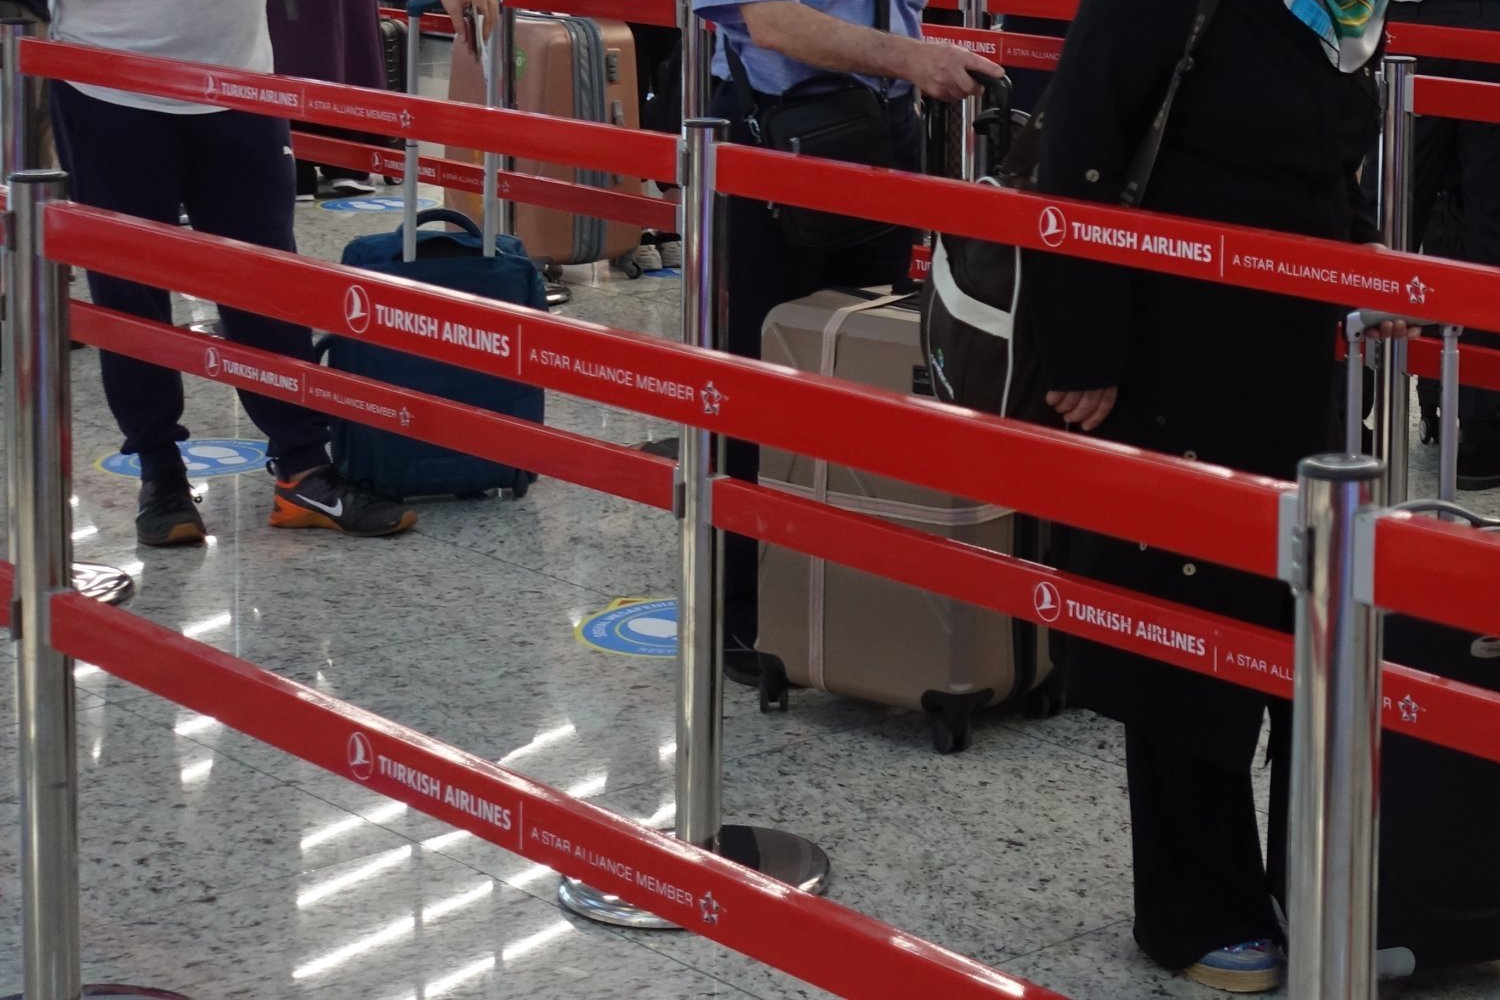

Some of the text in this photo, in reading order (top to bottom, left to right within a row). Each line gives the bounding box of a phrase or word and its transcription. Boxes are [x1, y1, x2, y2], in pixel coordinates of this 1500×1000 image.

[958, 40, 997, 54] AIRLINES
[1031, 50, 1061, 61] ALLIANC
[220, 83, 258, 100] TURKISH
[259, 89, 299, 107] AIRLINES
[1071, 221, 1400, 295] TURKISH AIRLINES A STAR ALLIANCE MEMBER
[222, 358, 259, 381] TURKISH
[260, 368, 299, 393] AIRLINES
[315, 388, 333, 402] STAR
[333, 392, 365, 412] ALLIANCE
[365, 401, 397, 419] MEMBER
[375, 303, 696, 402] TURKISH AIRLINES A STAR ALLIANCE MEMBER
[1066, 599, 1132, 635] TURKISH
[1135, 620, 1206, 656] AIRLINES
[1226, 652, 1235, 664] A
[1237, 655, 1269, 675] STAR
[377, 754, 694, 909] TURKISH AIRLINES A STAR ALLIANCE MEMBER
